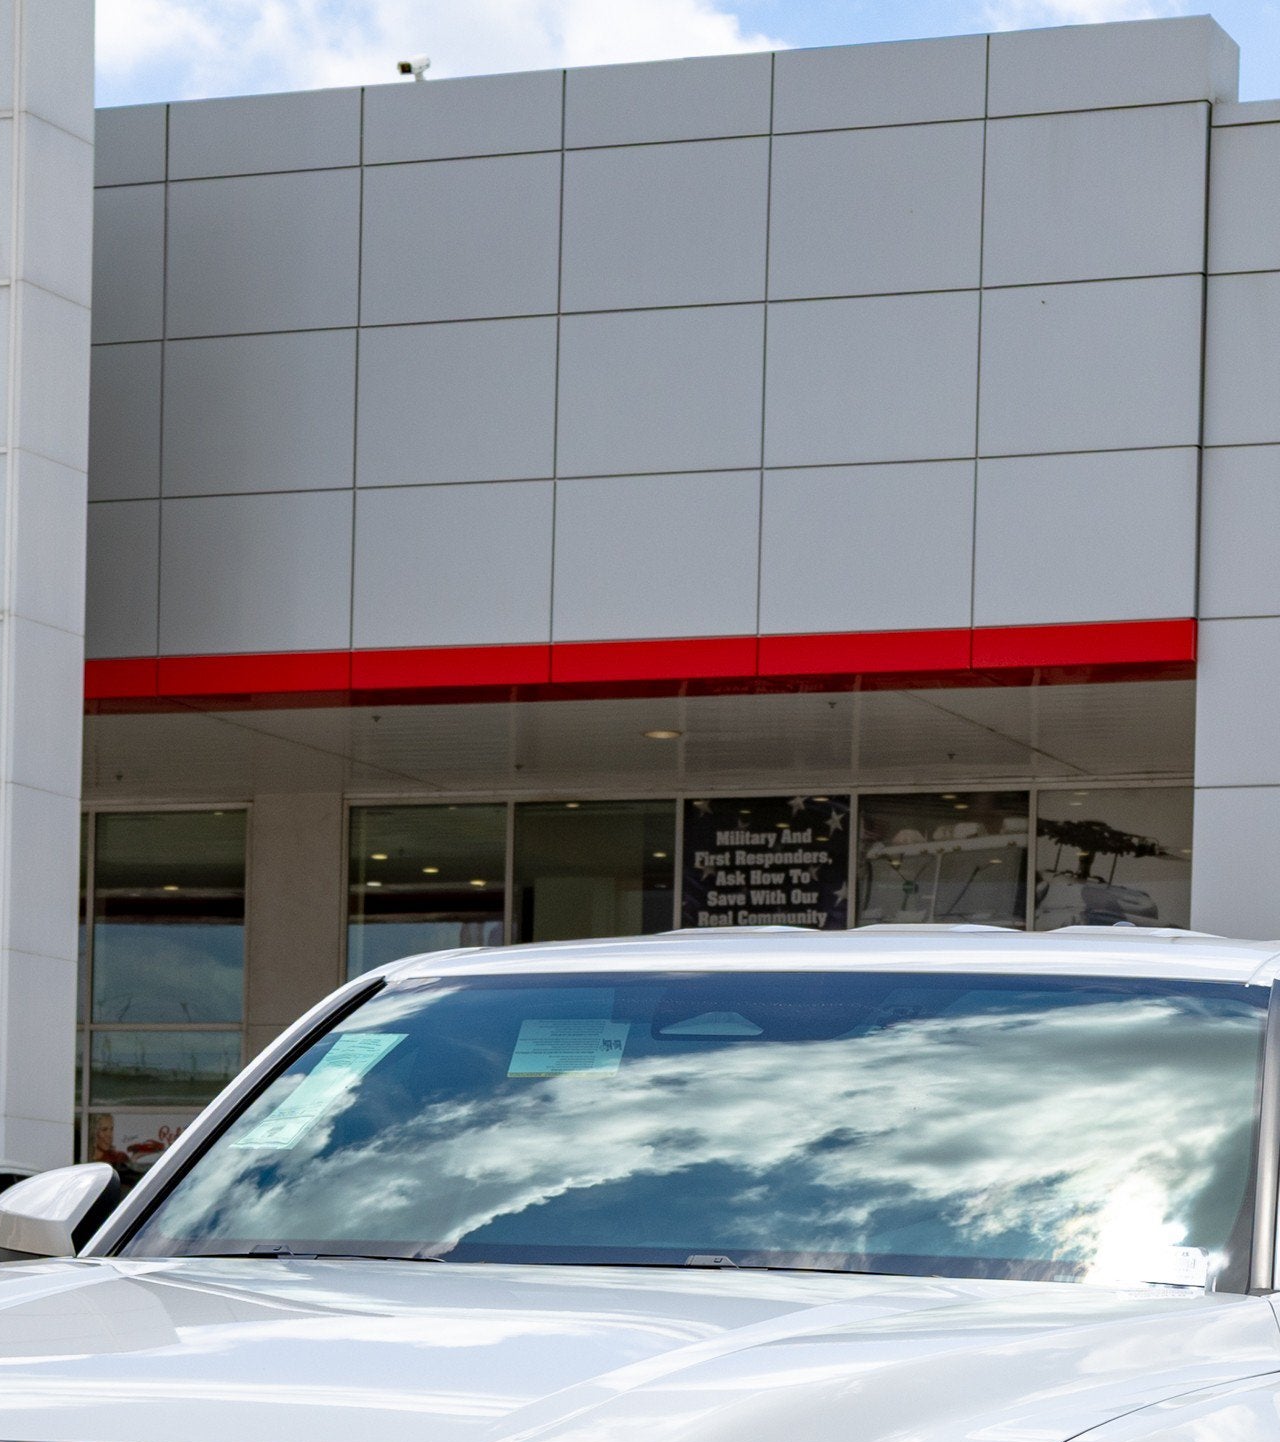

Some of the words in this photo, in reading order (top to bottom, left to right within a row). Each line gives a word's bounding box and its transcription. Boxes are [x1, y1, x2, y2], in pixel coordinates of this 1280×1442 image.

[716, 829, 777, 848] Military
[780, 828, 812, 844] And
[694, 851, 731, 867] First
[735, 849, 833, 868] Responders,
[715, 870, 746, 886] Ask
[750, 870, 785, 885] How
[791, 869, 811, 884] To
[706, 891, 746, 907] Save
[751, 889, 786, 906] With
[791, 888, 818, 904] Our
[698, 910, 733, 926] Real
[737, 909, 827, 928] Community
